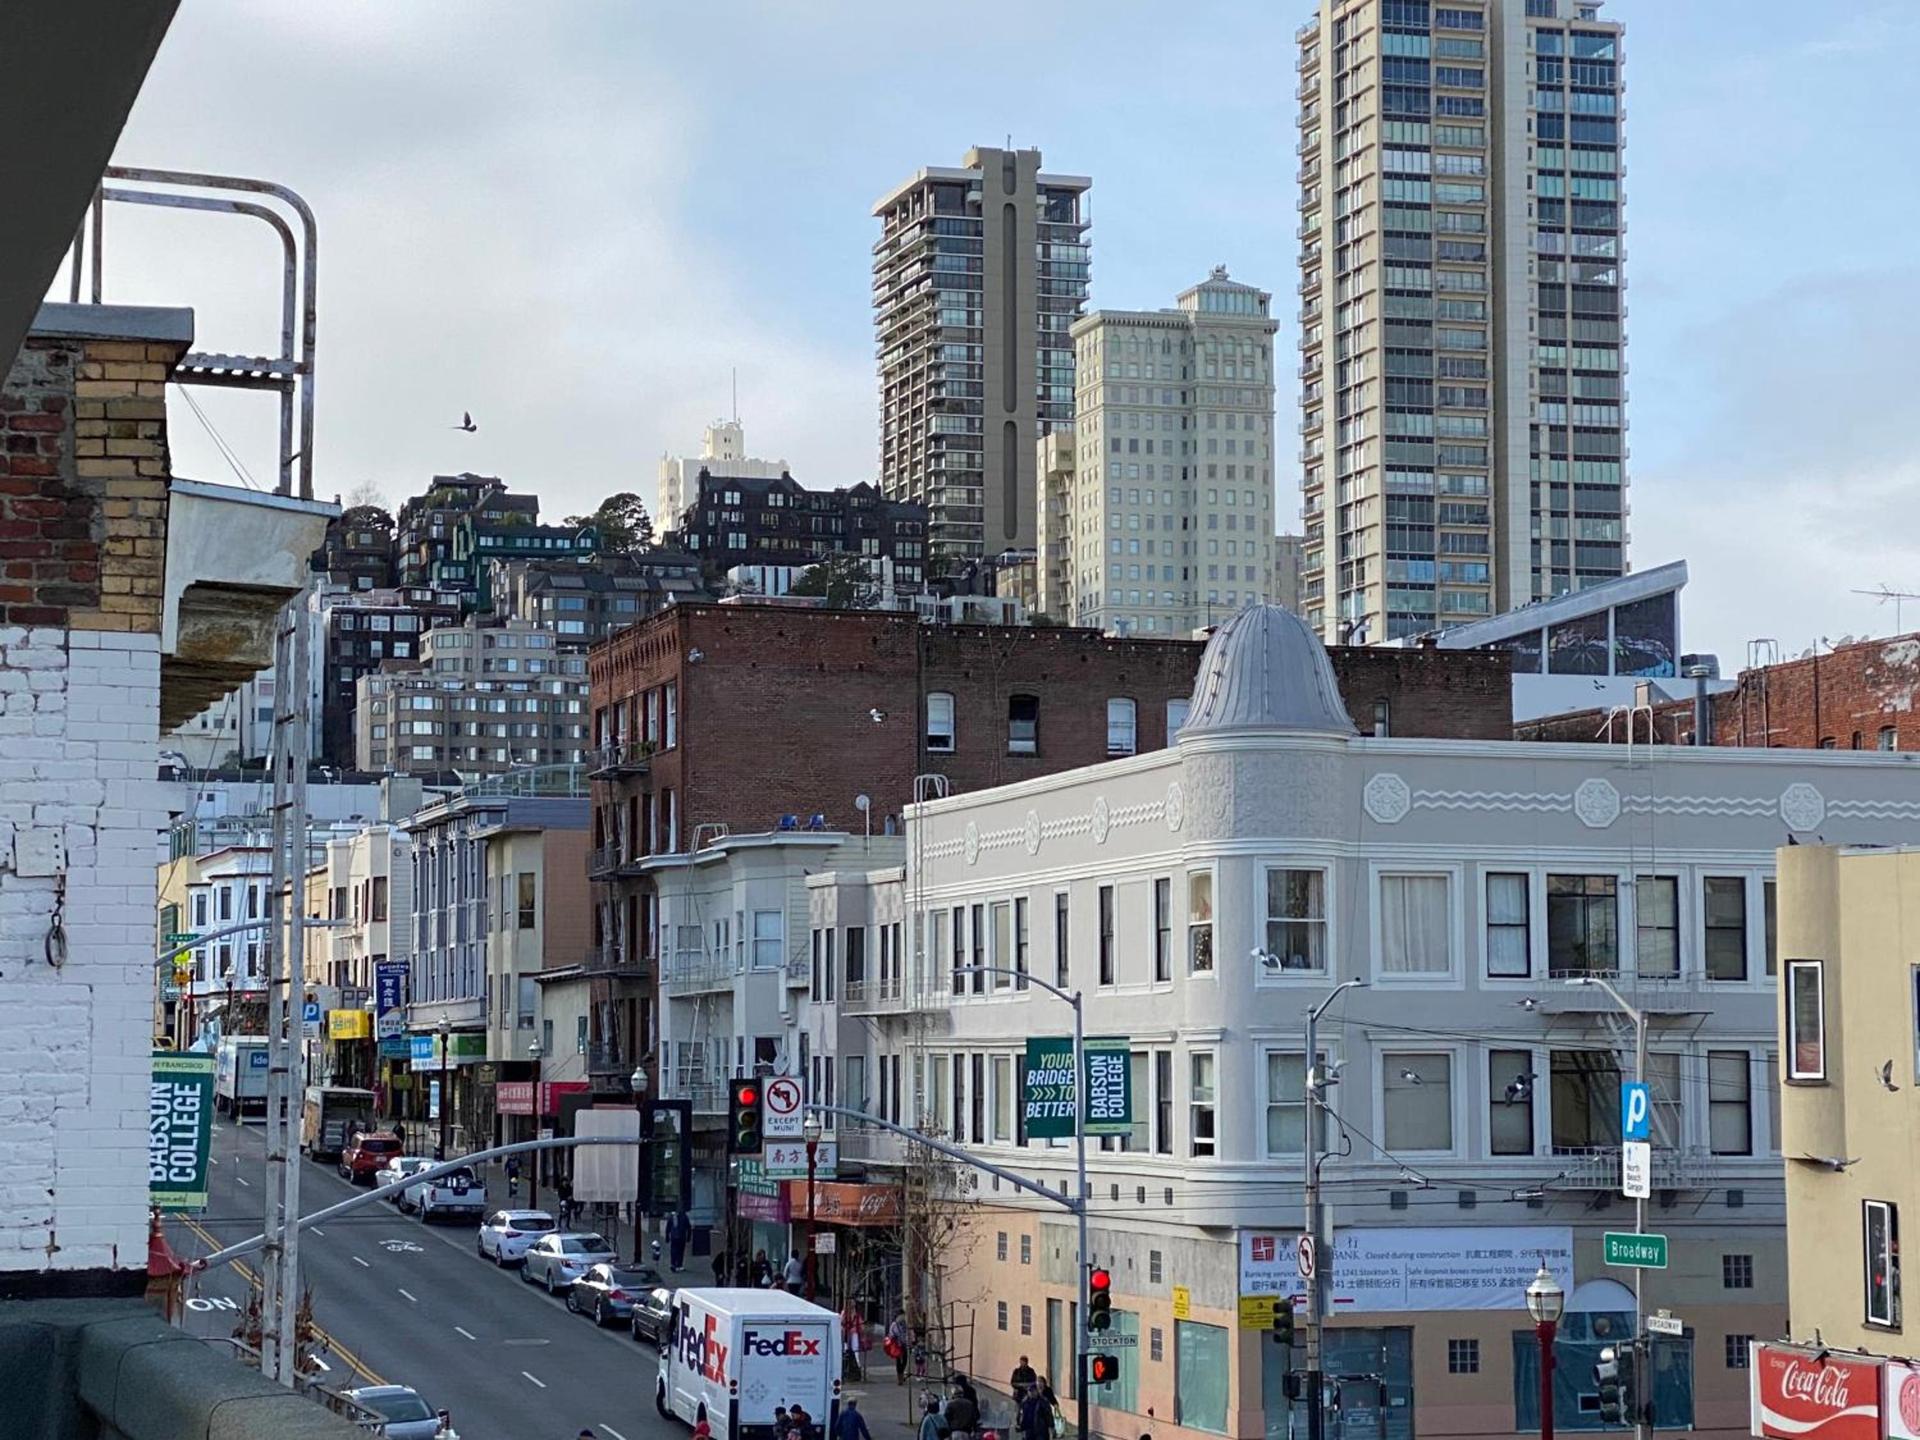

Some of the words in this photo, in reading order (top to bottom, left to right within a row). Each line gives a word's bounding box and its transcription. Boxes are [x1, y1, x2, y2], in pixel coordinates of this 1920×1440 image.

[1041, 1053, 1075, 1069] YOUR
[1026, 1069, 1075, 1086] BRIDGE
[1059, 1085, 1076, 1101] TO
[1090, 1055, 1108, 1118] BABSON
[1108, 1055, 1125, 1118] COLLEGE
[1026, 1101, 1075, 1118] BETTER
[767, 1117, 799, 1125] EXCEPT
[149, 1082, 172, 1182] BABSON
[169, 1082, 201, 1182] COLLEGE
[1279, 1251, 1297, 1262] EAS
[1332, 1250, 1360, 1260] BANK
[1365, 1250, 1390, 1260] Closed
[1612, 1240, 1660, 1264] Broadway
[1359, 1268, 1390, 1276] Stockton
[1482, 1279, 1497, 1288] 555
[679, 1301, 728, 1388] FedEx
[743, 1331, 821, 1357] FedEx
[1091, 1336, 1136, 1346] STOCKTON
[1781, 1360, 1851, 1409] Coca-Cola
